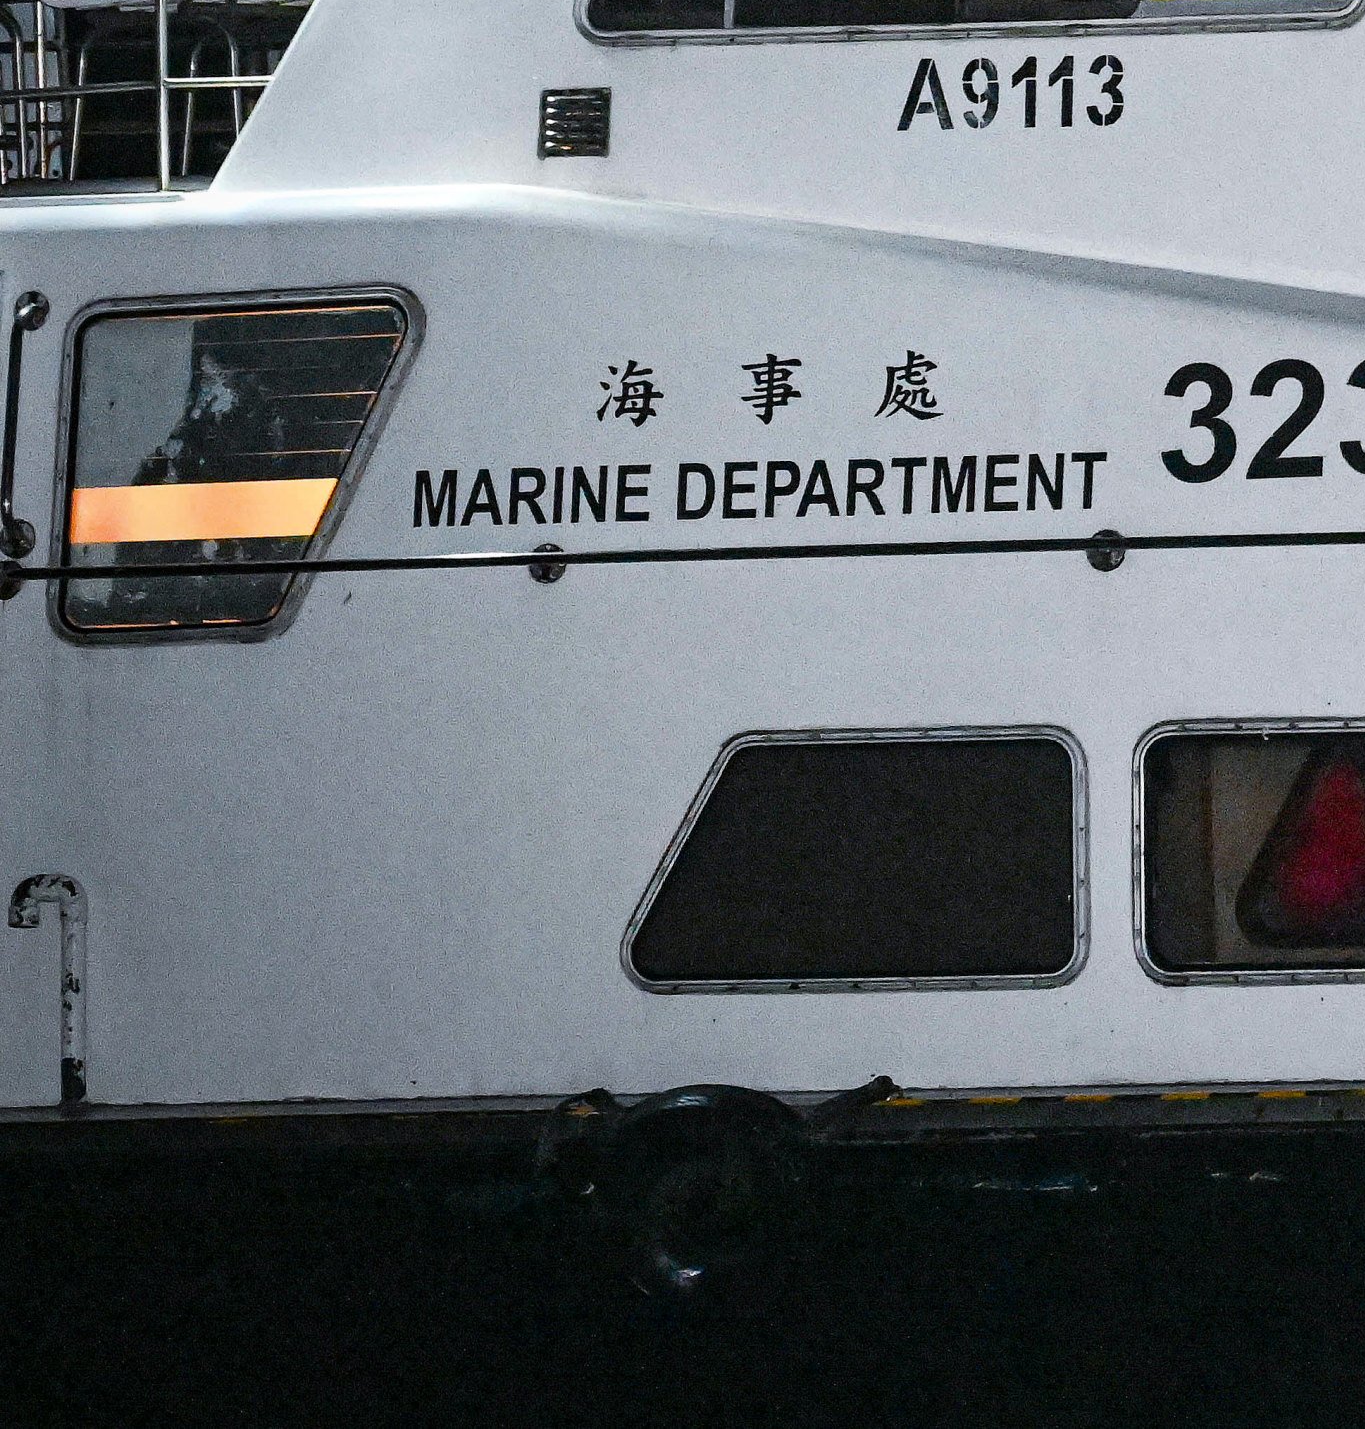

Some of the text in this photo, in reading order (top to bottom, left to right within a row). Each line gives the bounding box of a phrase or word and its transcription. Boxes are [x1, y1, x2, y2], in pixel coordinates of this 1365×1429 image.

[897, 54, 1124, 131] A9113
[597, 350, 944, 427] 海事處
[413, 451, 1108, 528] MARINE DEPARTMENT
